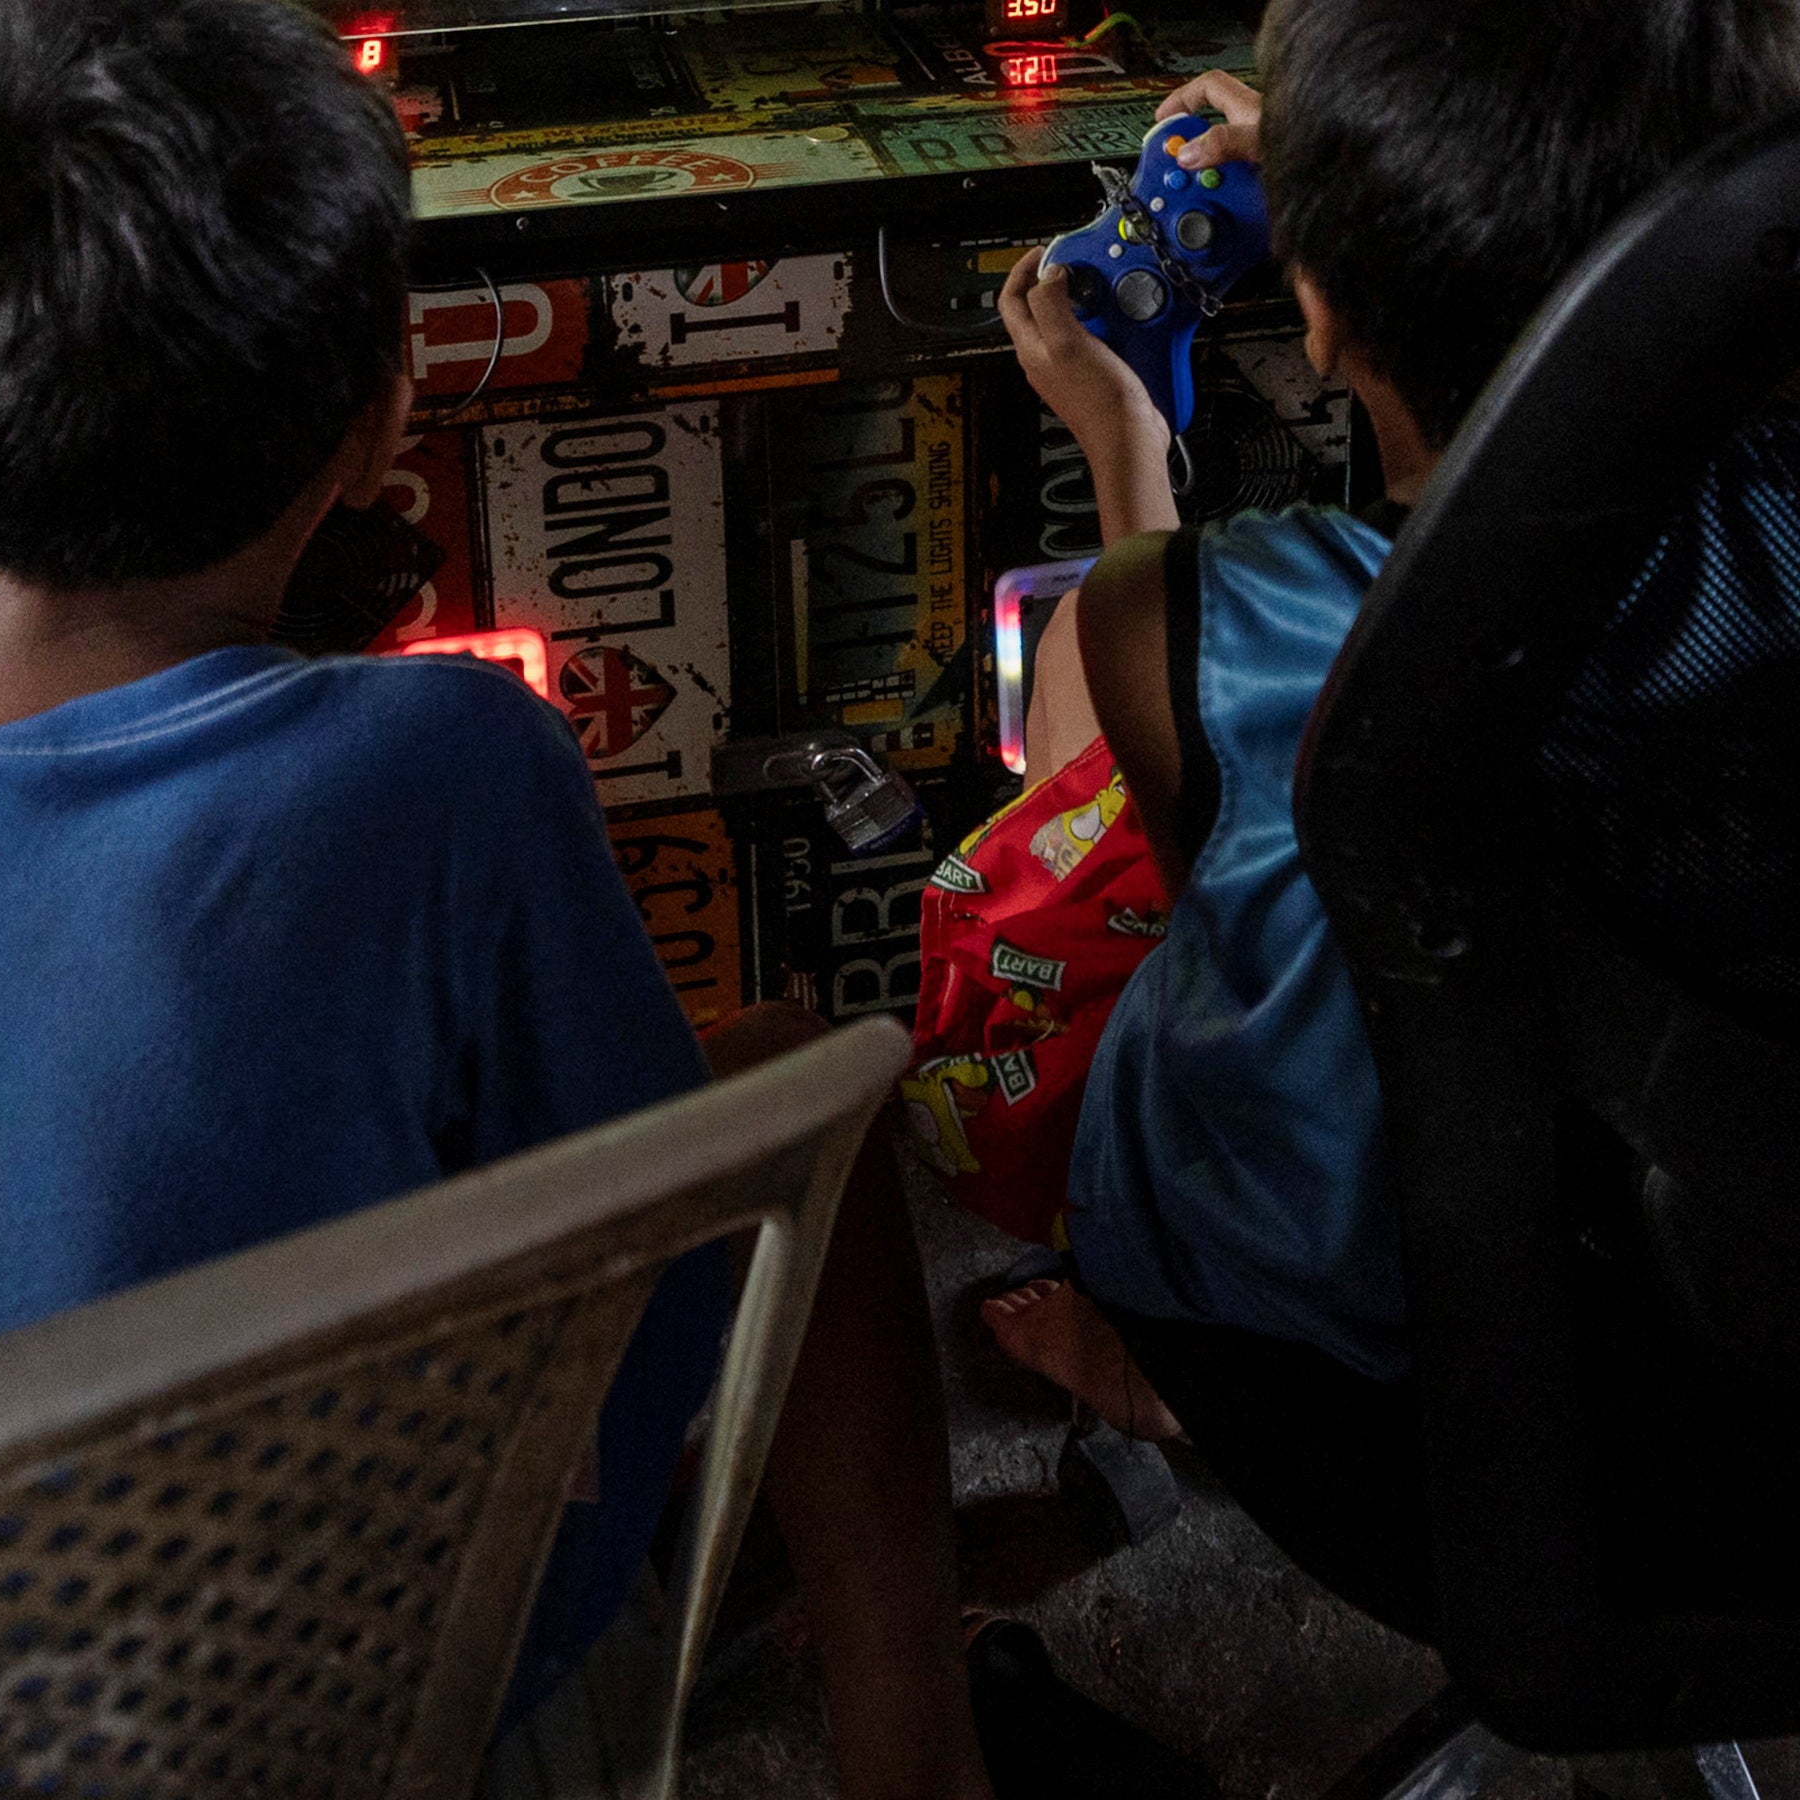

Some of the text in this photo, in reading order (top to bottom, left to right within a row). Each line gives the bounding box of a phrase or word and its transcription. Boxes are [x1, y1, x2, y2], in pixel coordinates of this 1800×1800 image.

[361, 40, 382, 67] 8
[519, 151, 722, 184] COFFEE
[929, 440, 953, 506] SHINING
[929, 514, 954, 576] LIGHTS
[928, 583, 953, 614] THE
[1001, 953, 1052, 980] BART
